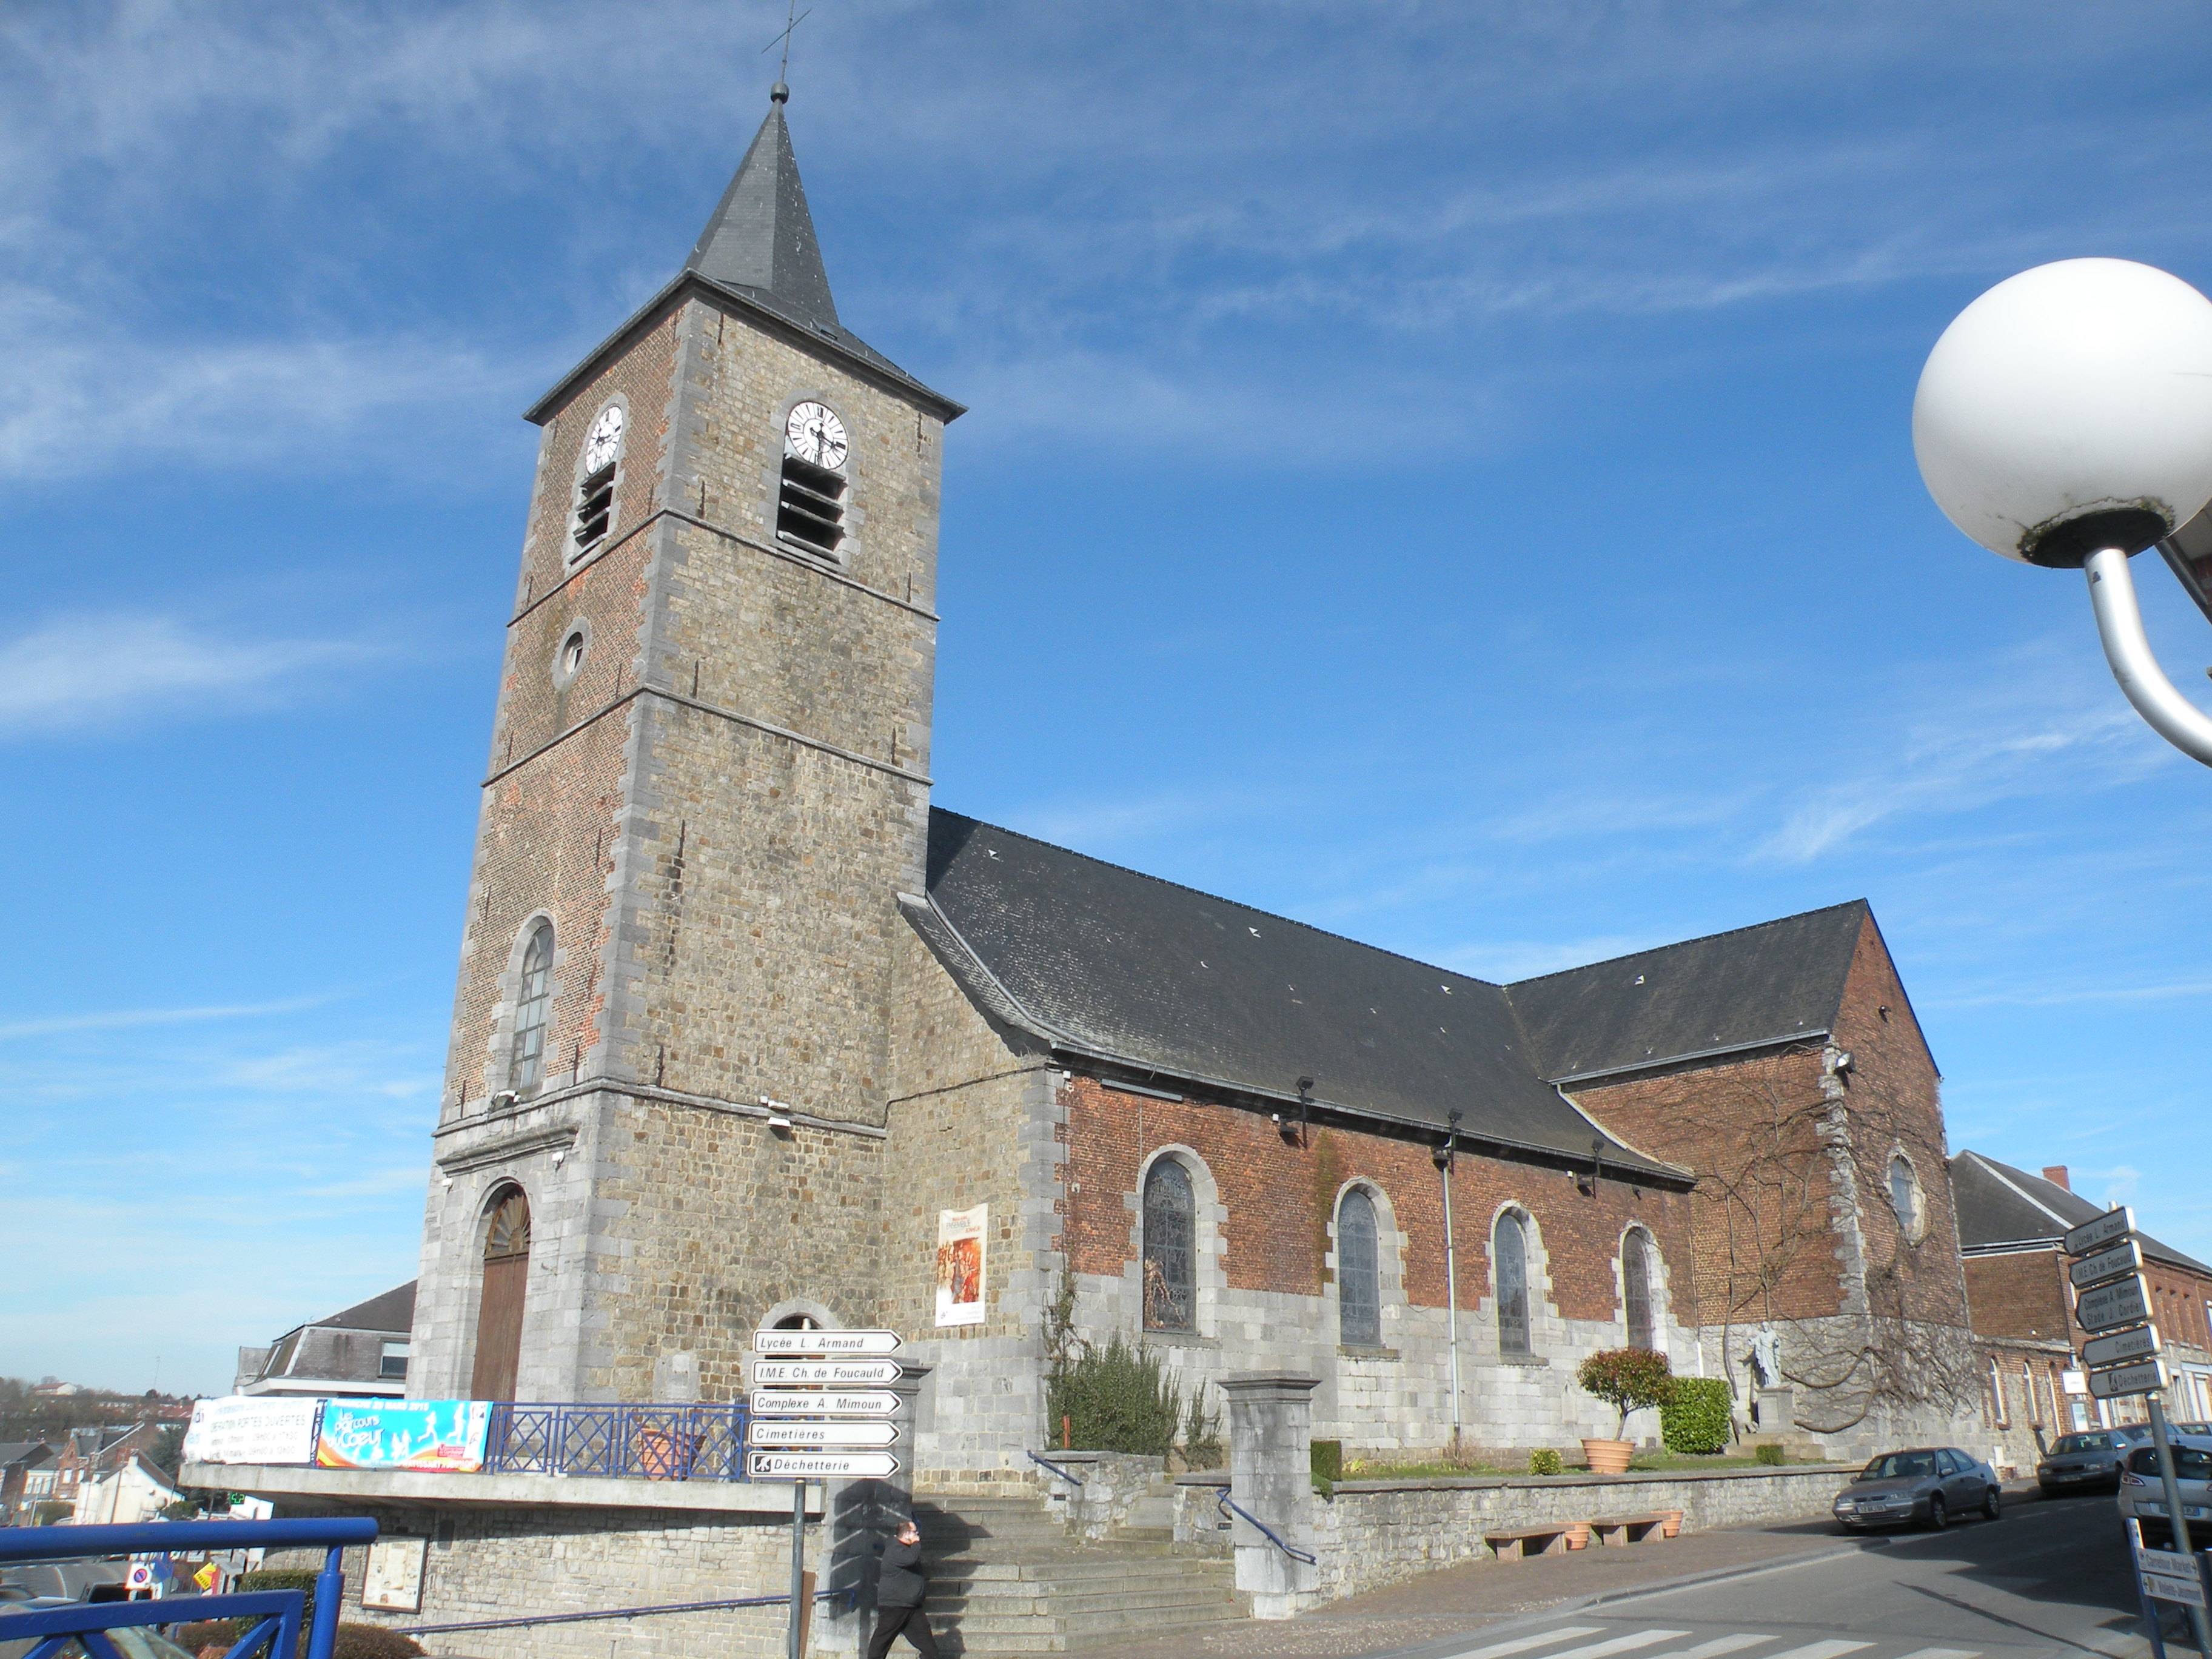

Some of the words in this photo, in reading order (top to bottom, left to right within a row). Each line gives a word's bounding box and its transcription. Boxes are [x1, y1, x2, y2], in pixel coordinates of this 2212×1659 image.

[760, 1337, 791, 1350] Lycée
[800, 1338, 810, 1347] L.
[819, 1338, 864, 1348] Armand
[760, 1368, 787, 1378] I.M.E.
[793, 1368, 809, 1378] Ch.
[814, 1368, 827, 1378] de
[834, 1367, 884, 1378] Foucauld
[757, 1397, 809, 1410] Complexe
[817, 1398, 828, 1409] A.
[836, 1398, 882, 1409] Mimoun
[338, 1407, 354, 1421] Les
[265, 1415, 306, 1427] OUVERTES
[334, 1414, 381, 1433] parcours
[756, 1428, 825, 1439] Cimetières
[774, 1459, 850, 1470] Déchetterie
